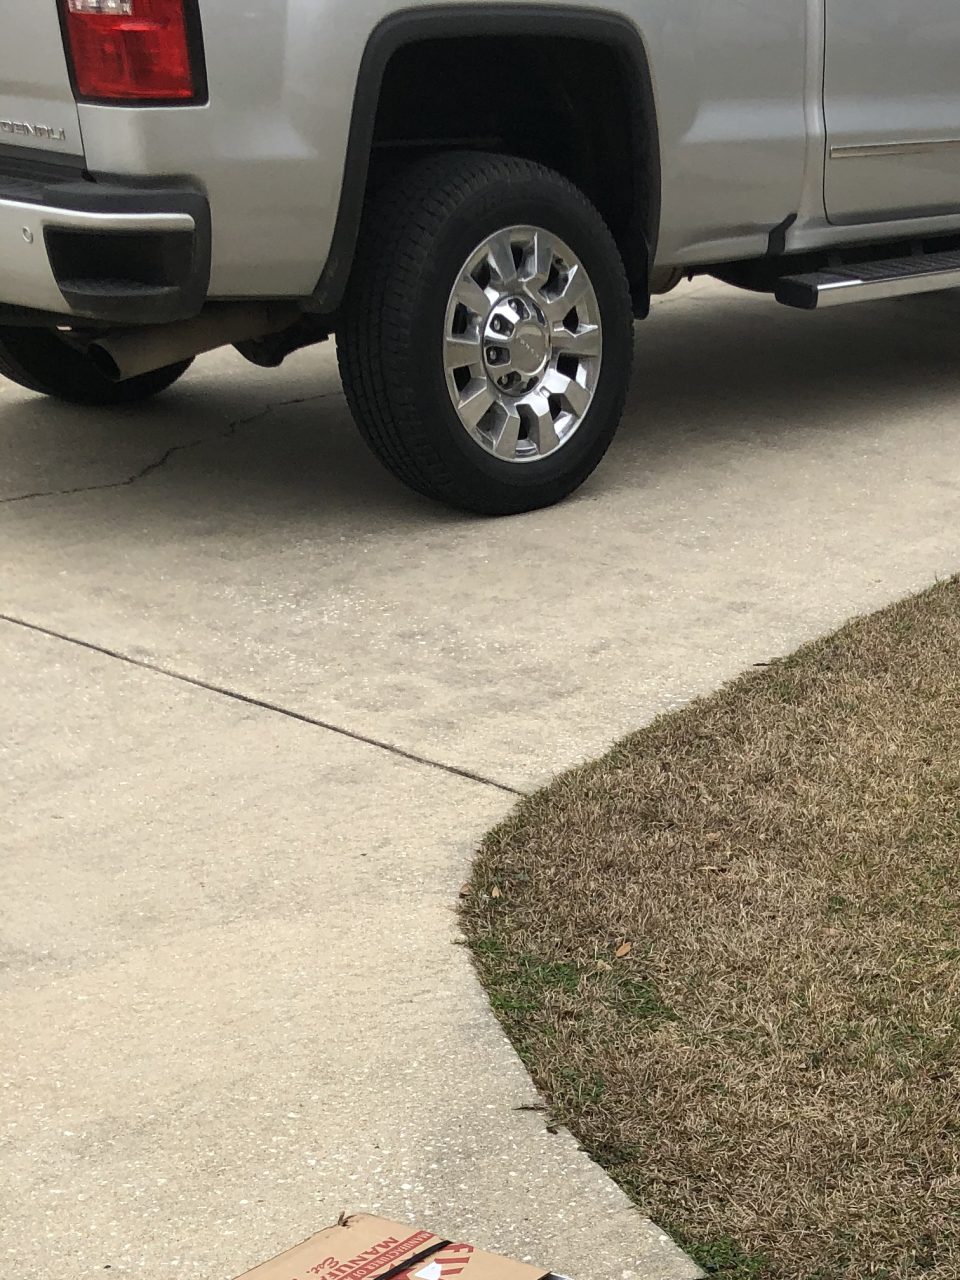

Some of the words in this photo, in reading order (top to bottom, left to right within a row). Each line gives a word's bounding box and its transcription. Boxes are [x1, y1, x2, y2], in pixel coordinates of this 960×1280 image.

[362, 1232, 431, 1270] MANUFACTURER
[305, 1256, 343, 1276] Est.
[350, 1269, 368, 1277] OF
